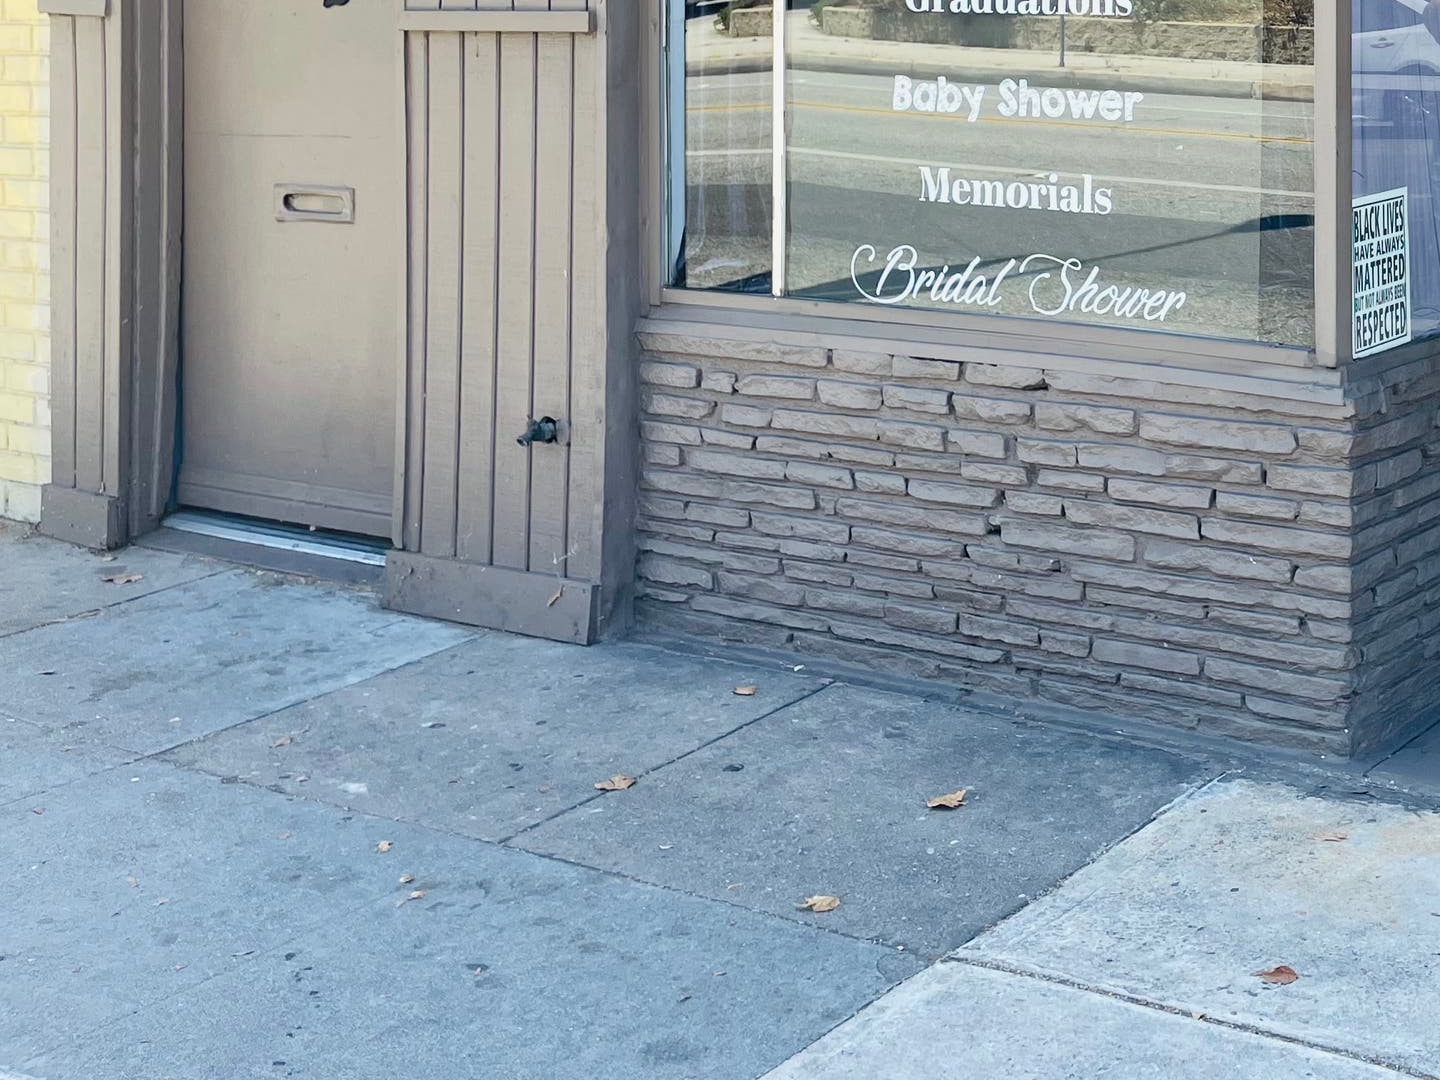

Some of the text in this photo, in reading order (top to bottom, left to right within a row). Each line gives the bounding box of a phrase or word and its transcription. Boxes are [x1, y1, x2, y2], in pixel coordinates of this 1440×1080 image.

[893, 75, 1144, 122] Baby Shower
[918, 166, 1113, 215] Memorials
[1353, 199, 1404, 243] BLACK LIVES
[1354, 233, 1404, 262] HAVE ALWAYS
[851, 245, 1186, 321] Bridal Shower
[1354, 252, 1405, 294] MATTERED
[1354, 295, 1364, 312] BUT
[1365, 293, 1375, 308] NOT
[1376, 286, 1393, 305] ALWAYS
[1355, 305, 1407, 350] RESPECTED
